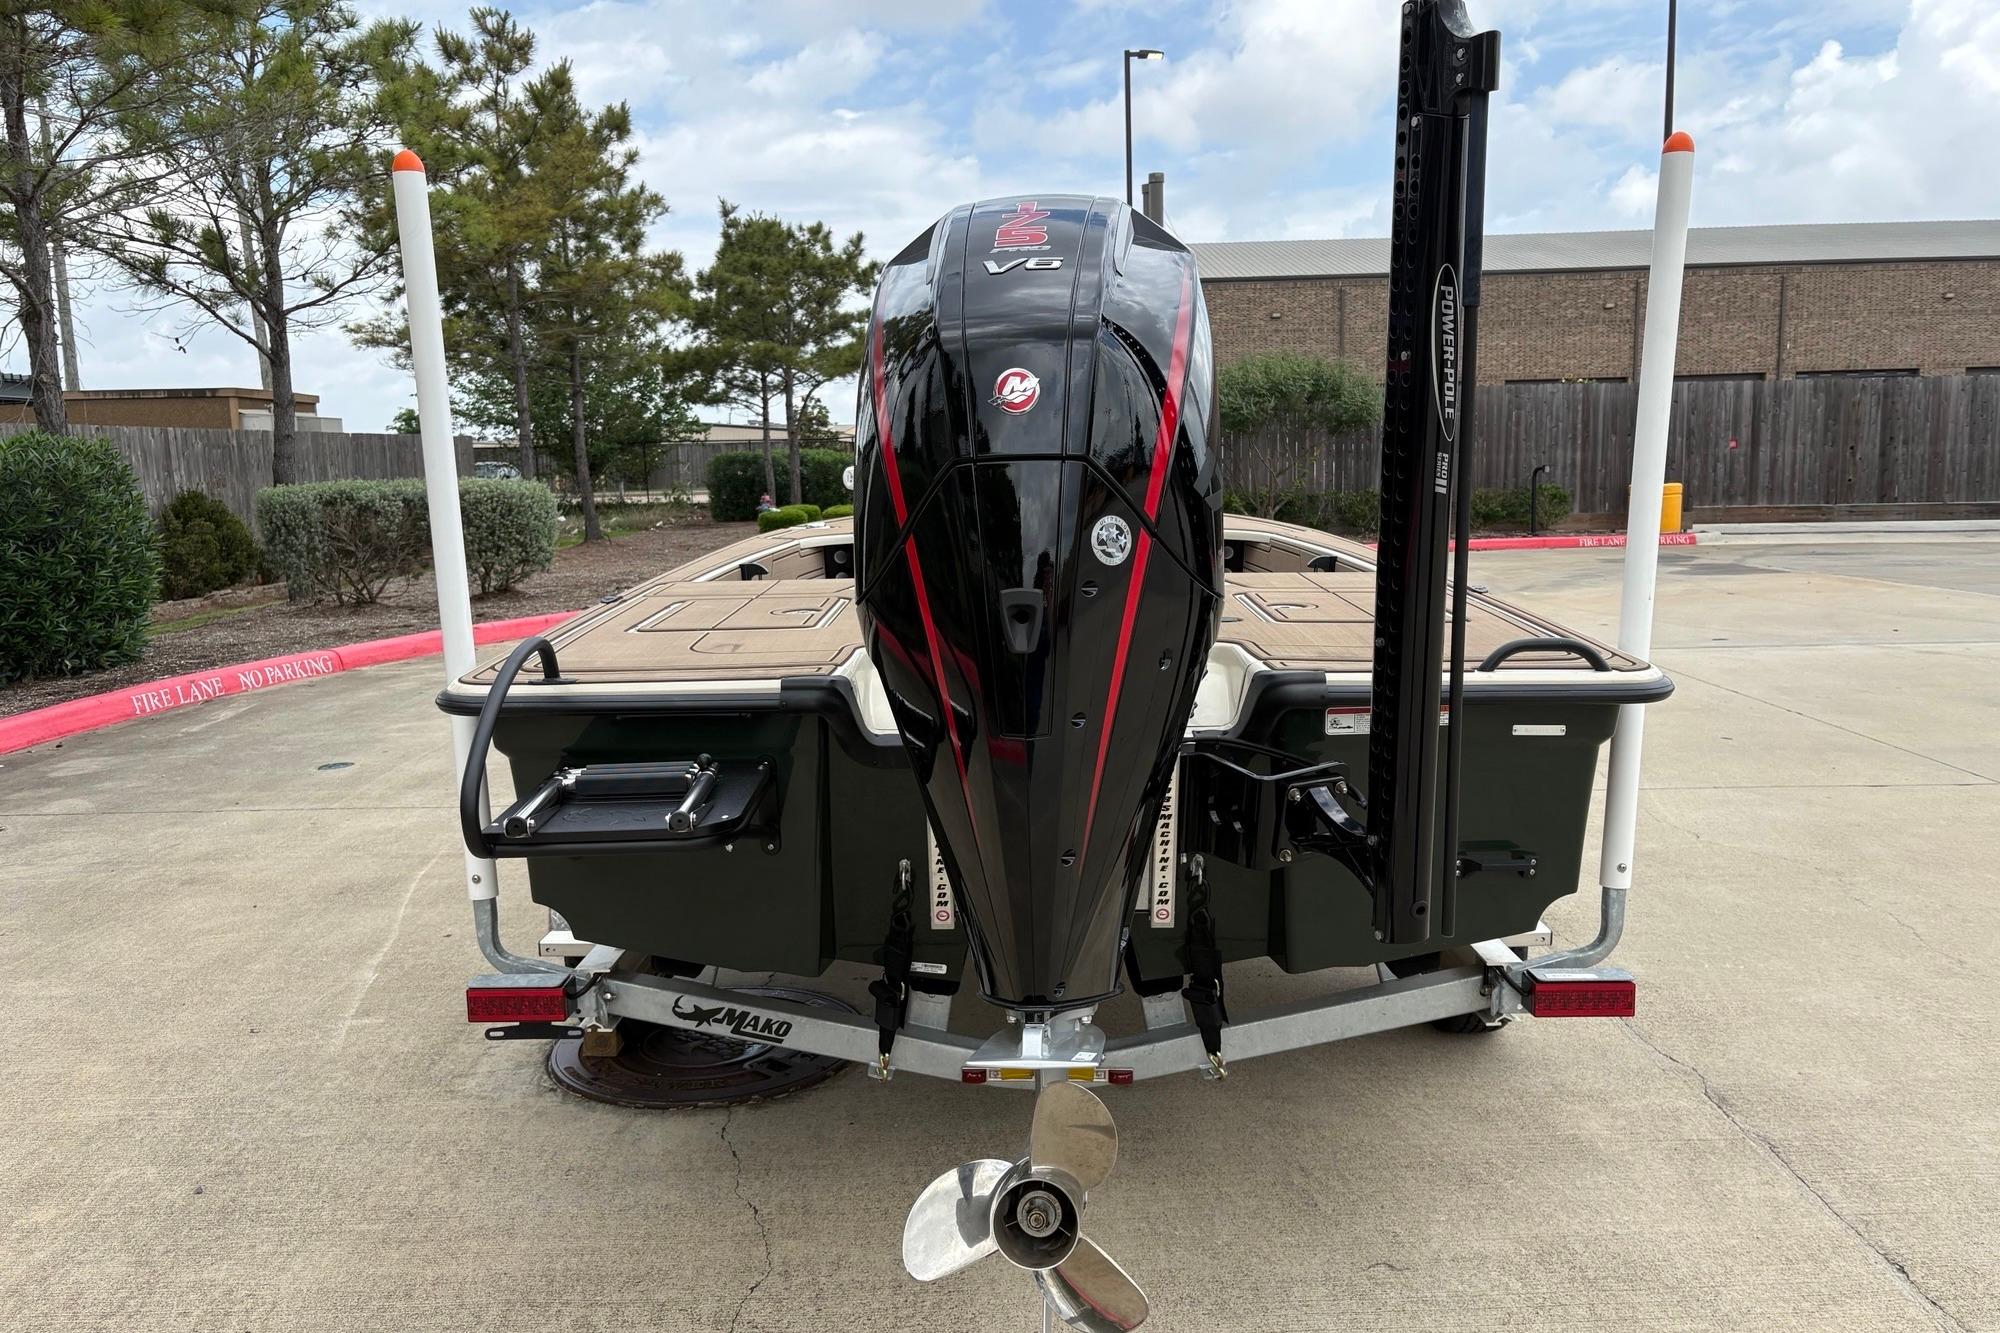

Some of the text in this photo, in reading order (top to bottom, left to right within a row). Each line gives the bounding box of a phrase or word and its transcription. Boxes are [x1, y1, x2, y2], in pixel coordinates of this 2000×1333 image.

[983, 257, 1064, 275] V6
[1440, 285, 1455, 420] POWER-POLE
[1579, 535, 1690, 547] FIRE LANE RKING
[130, 655, 334, 715] FIRE LANE NO PARKING
[712, 1007, 793, 1044] MAKO
